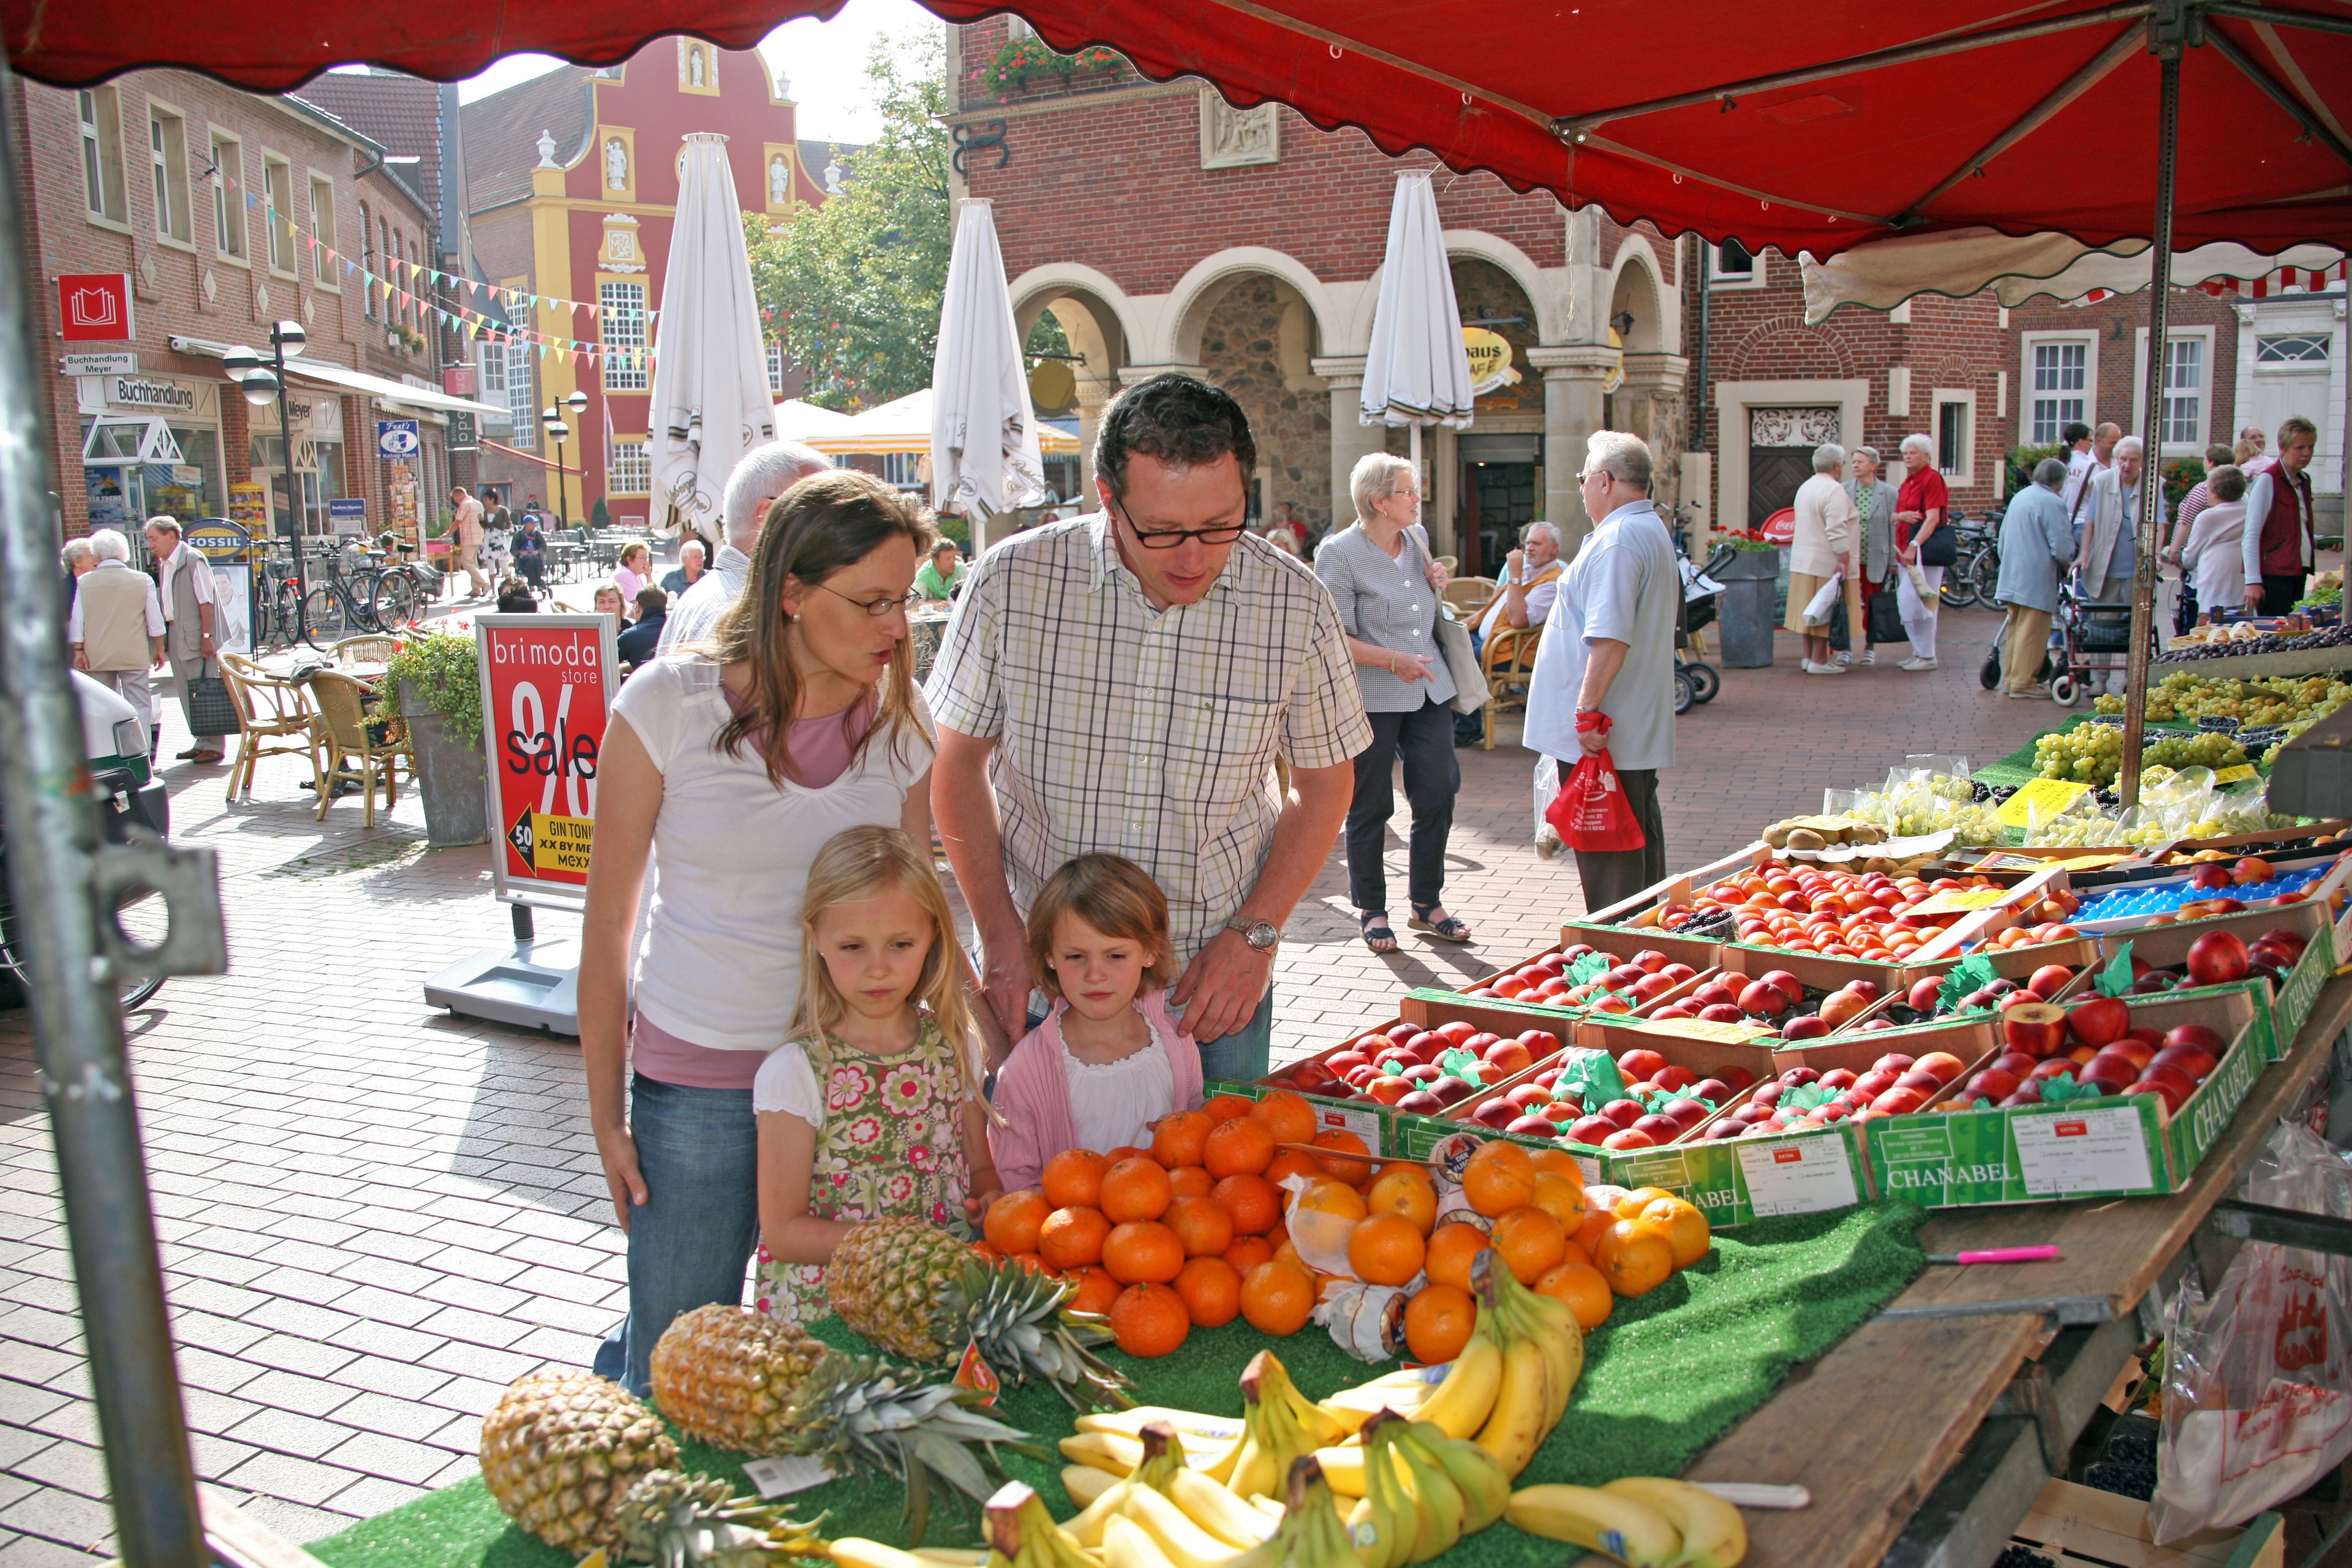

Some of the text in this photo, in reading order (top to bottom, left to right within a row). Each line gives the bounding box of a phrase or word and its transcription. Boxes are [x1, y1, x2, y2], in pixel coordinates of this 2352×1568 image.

[68, 355, 128, 364] Buchhandlung
[118, 380, 192, 410] Buchhandlung
[289, 401, 311, 421] Meyer
[456, 372, 473, 442] brioda
[1776, 520, 1795, 530] Coca-C
[188, 537, 241, 547] FOSSIL
[493, 631, 597, 666] brimoda
[562, 668, 597, 684] store
[508, 718, 597, 779] sale
[516, 824, 533, 846] 50
[549, 821, 566, 837] GIN
[540, 839, 557, 850] XX
[560, 842, 573, 851] BY
[2288, 947, 2326, 1027] CHANABEL
[2194, 1049, 2255, 1152] CHANABEL
[1455, 1152, 1469, 1163] DER
[1888, 1163, 2018, 1189] CHANABEL
